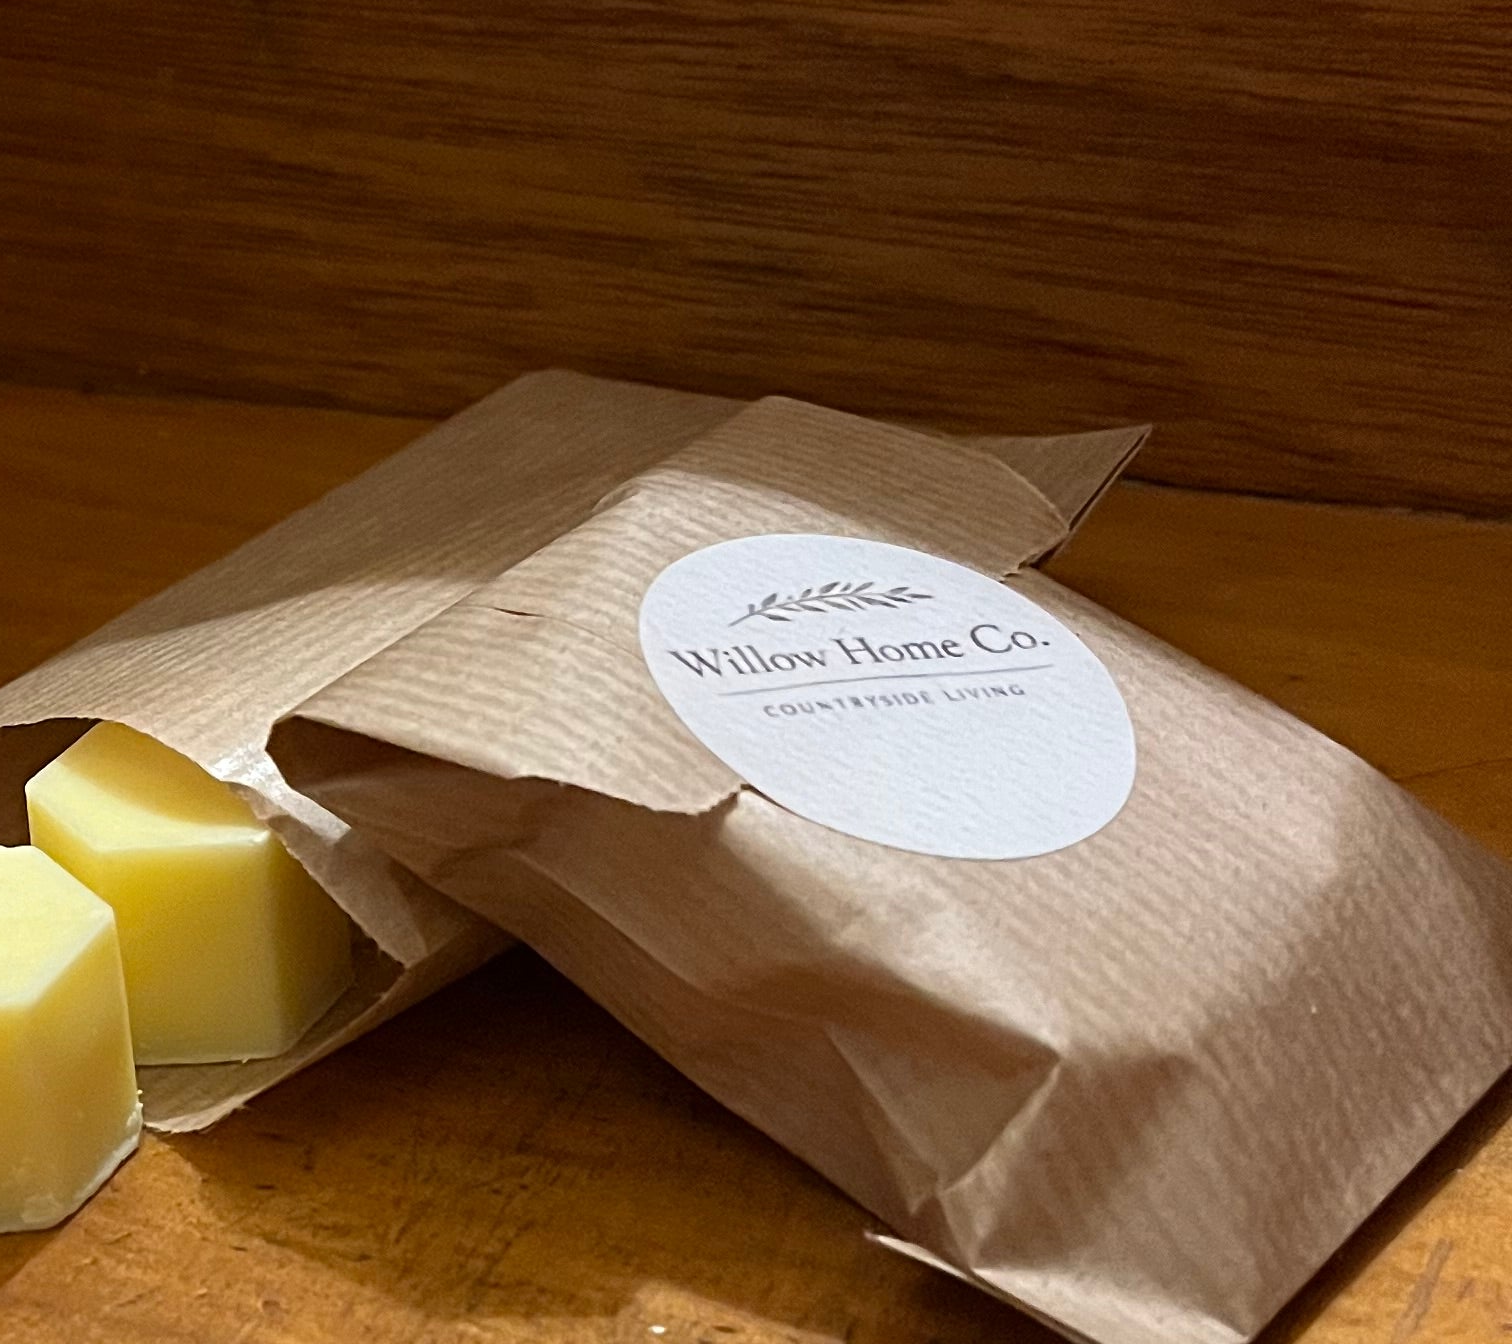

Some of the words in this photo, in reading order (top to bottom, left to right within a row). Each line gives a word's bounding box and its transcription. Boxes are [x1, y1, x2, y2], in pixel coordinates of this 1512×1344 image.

[668, 644, 827, 678] Willow
[832, 636, 965, 666] Home
[969, 623, 1050, 655] Co.
[763, 690, 931, 718] COUNTRYSIDE
[943, 683, 1026, 703] LIVING
